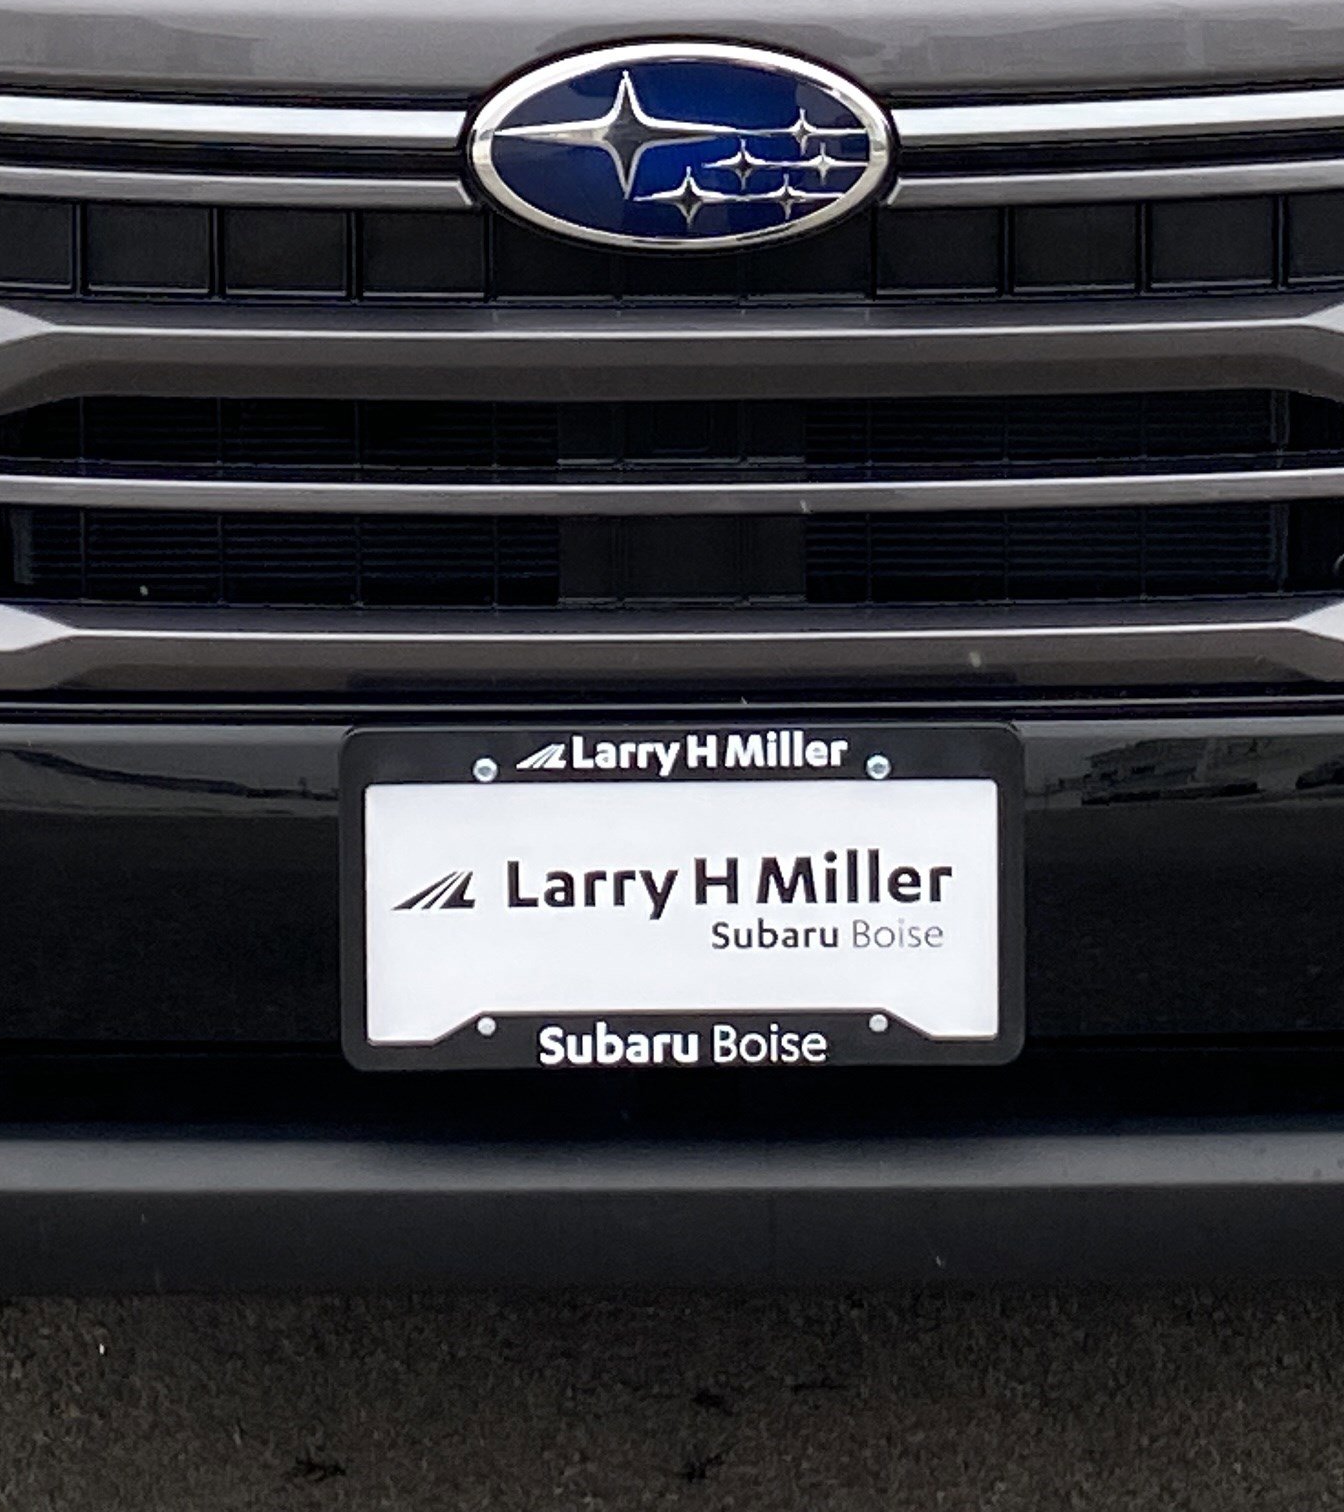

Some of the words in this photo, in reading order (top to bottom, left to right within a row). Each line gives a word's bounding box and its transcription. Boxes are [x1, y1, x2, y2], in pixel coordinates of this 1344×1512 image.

[572, 735, 681, 776] Larry
[687, 735, 718, 768] H
[724, 730, 849, 768] Miller
[506, 860, 679, 921] Larry
[694, 857, 739, 906] H
[756, 848, 954, 905] Miller
[711, 918, 840, 950] Subaru
[851, 918, 945, 949] Boise
[539, 1021, 699, 1065] Subaru
[713, 1023, 828, 1063] Boise
